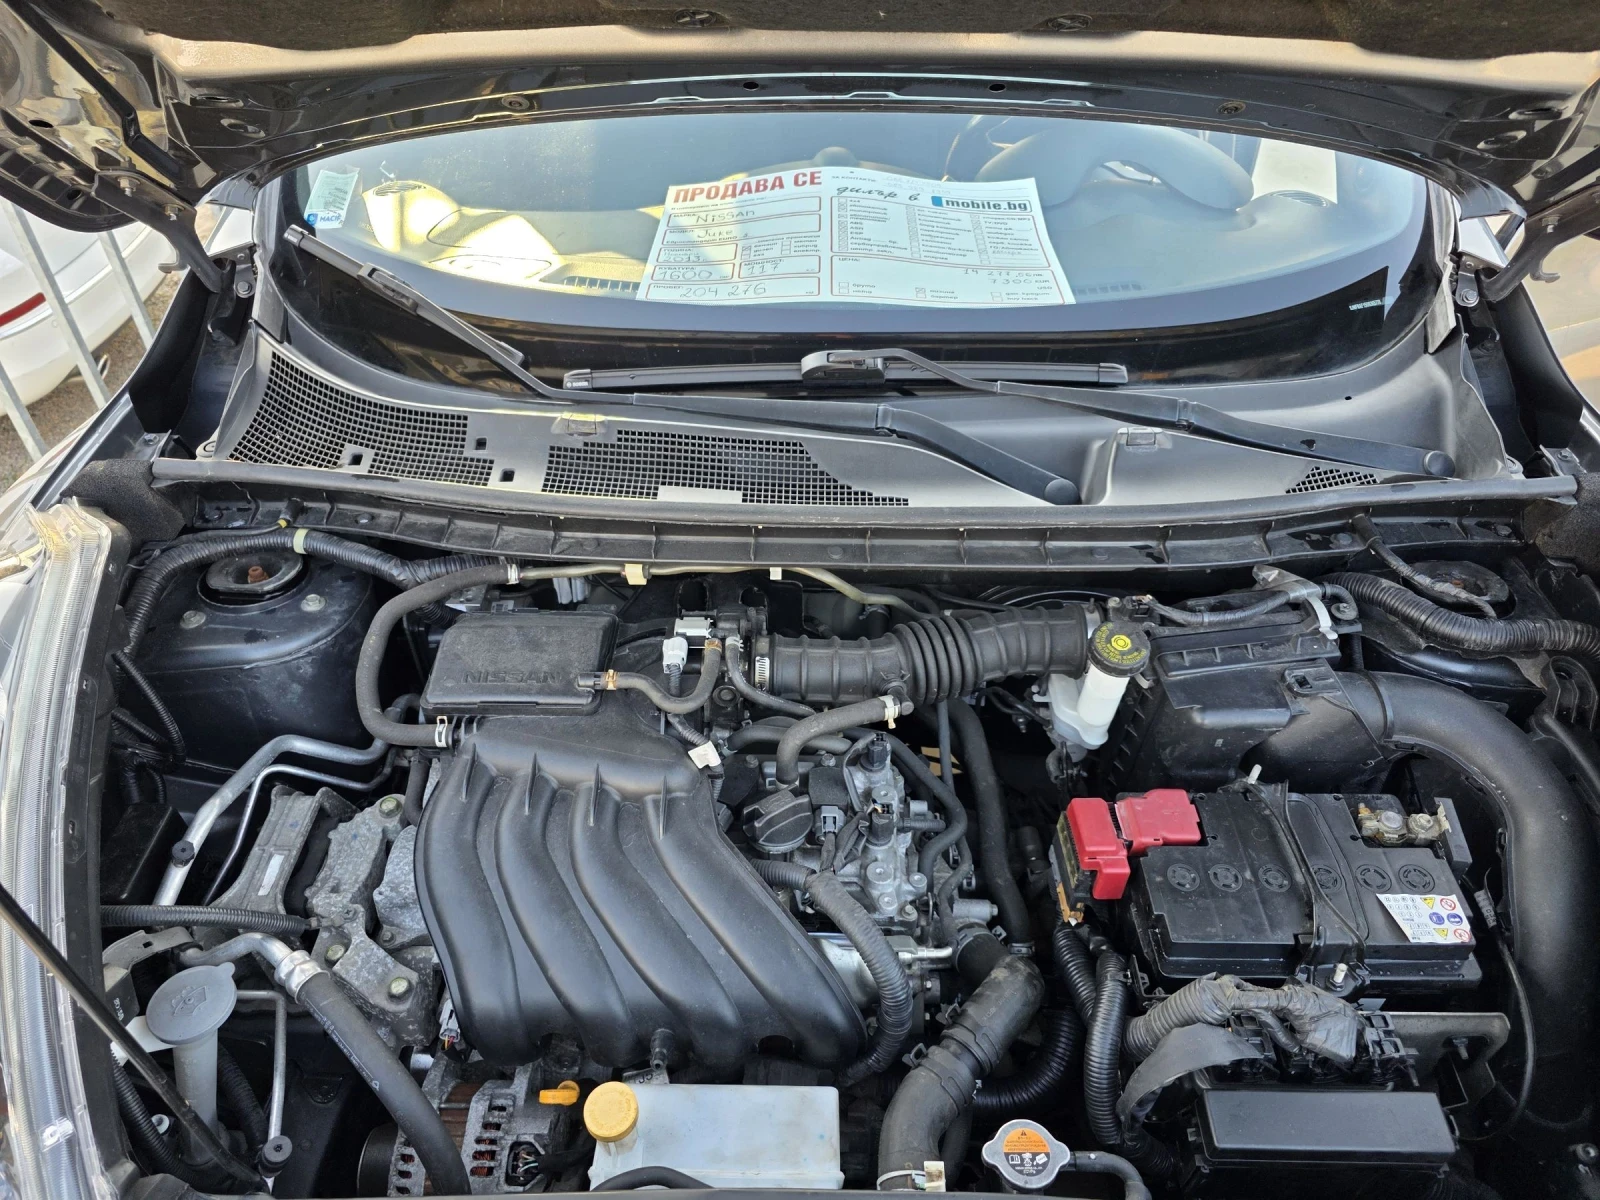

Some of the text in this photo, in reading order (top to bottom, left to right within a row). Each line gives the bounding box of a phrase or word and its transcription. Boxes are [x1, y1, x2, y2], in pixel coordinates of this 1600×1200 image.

[673, 175, 785, 203] ПРОДАВА
[793, 171, 823, 187] СЕ
[945, 198, 1028, 211] mobile.bg
[657, 269, 713, 280] 1600
[679, 282, 766, 298] 204 276
[461, 670, 561, 684] NISSAN
